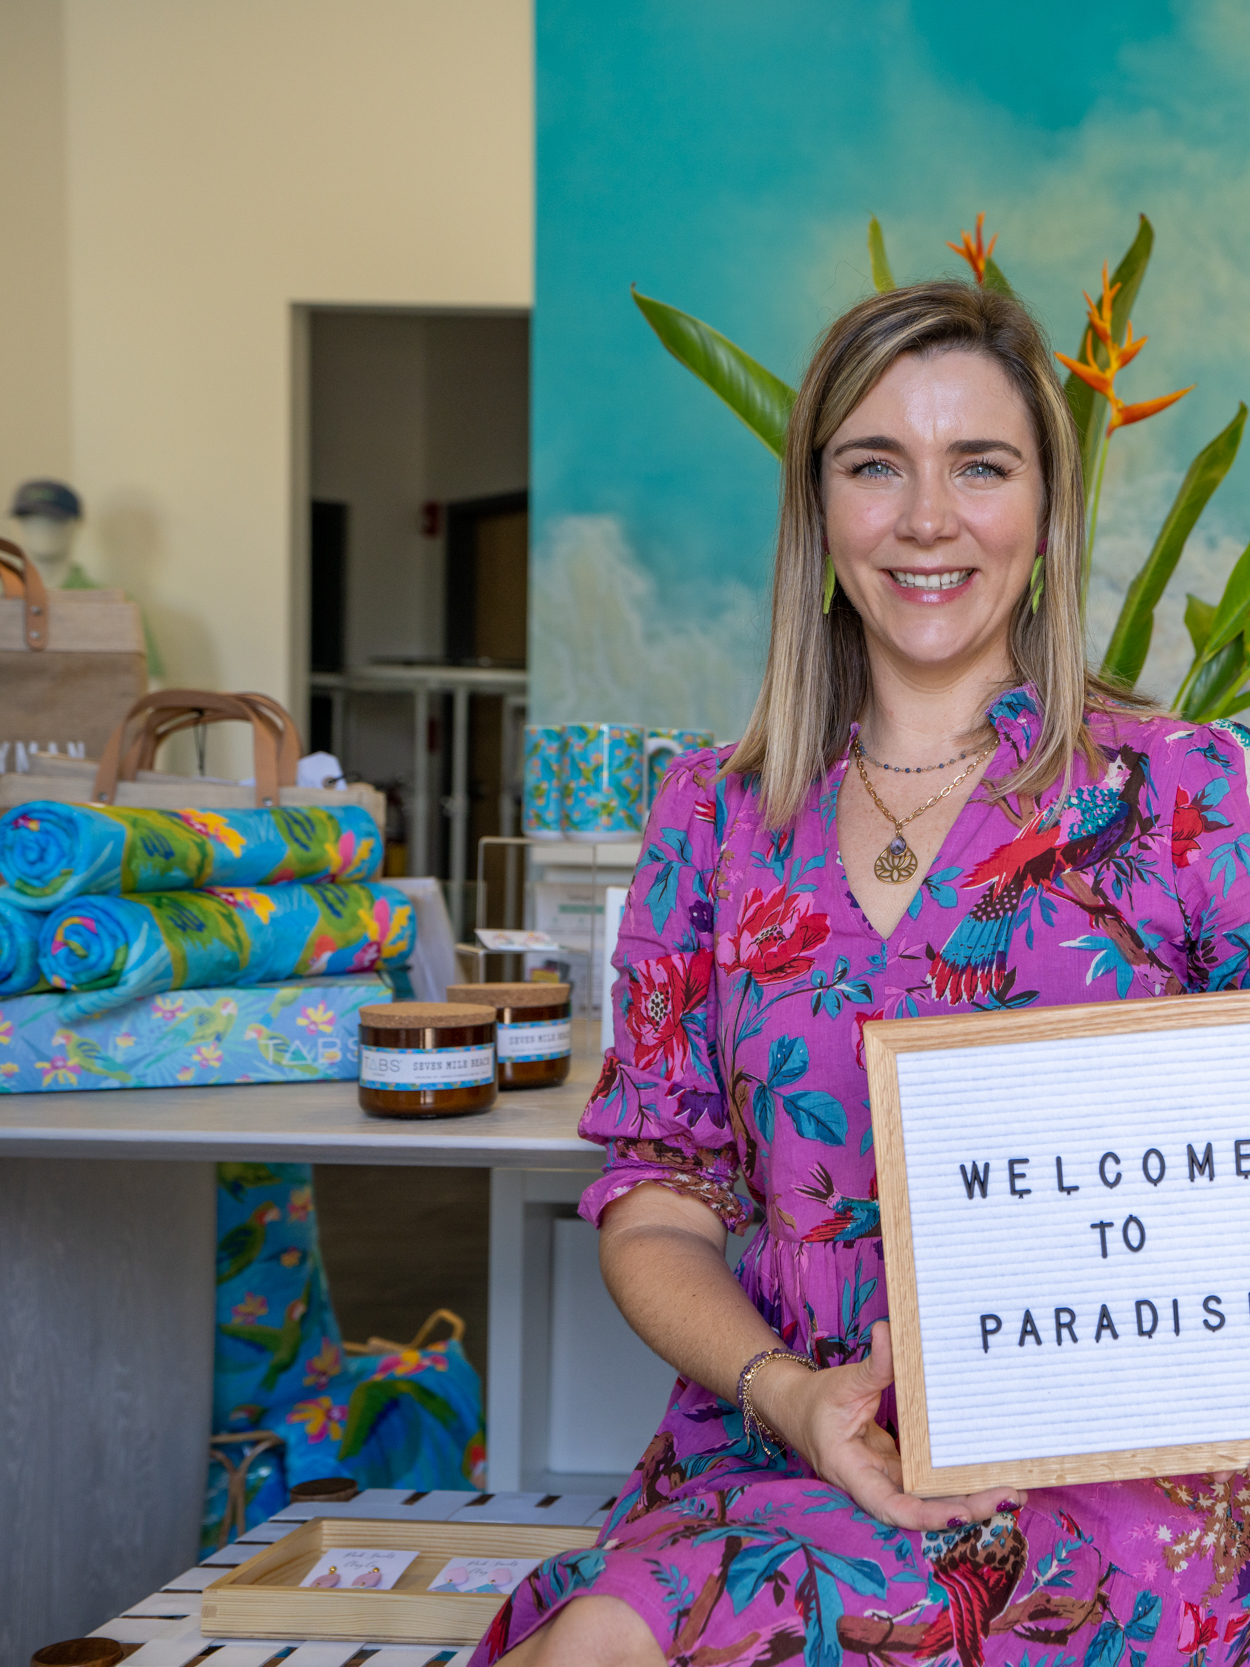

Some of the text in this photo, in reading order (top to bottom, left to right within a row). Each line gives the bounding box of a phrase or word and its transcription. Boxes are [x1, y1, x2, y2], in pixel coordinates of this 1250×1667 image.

[364, 1057, 401, 1073] TABS
[412, 1056, 491, 1072] SEVEN MILE BEACH
[1090, 1214, 1146, 1259] TO
